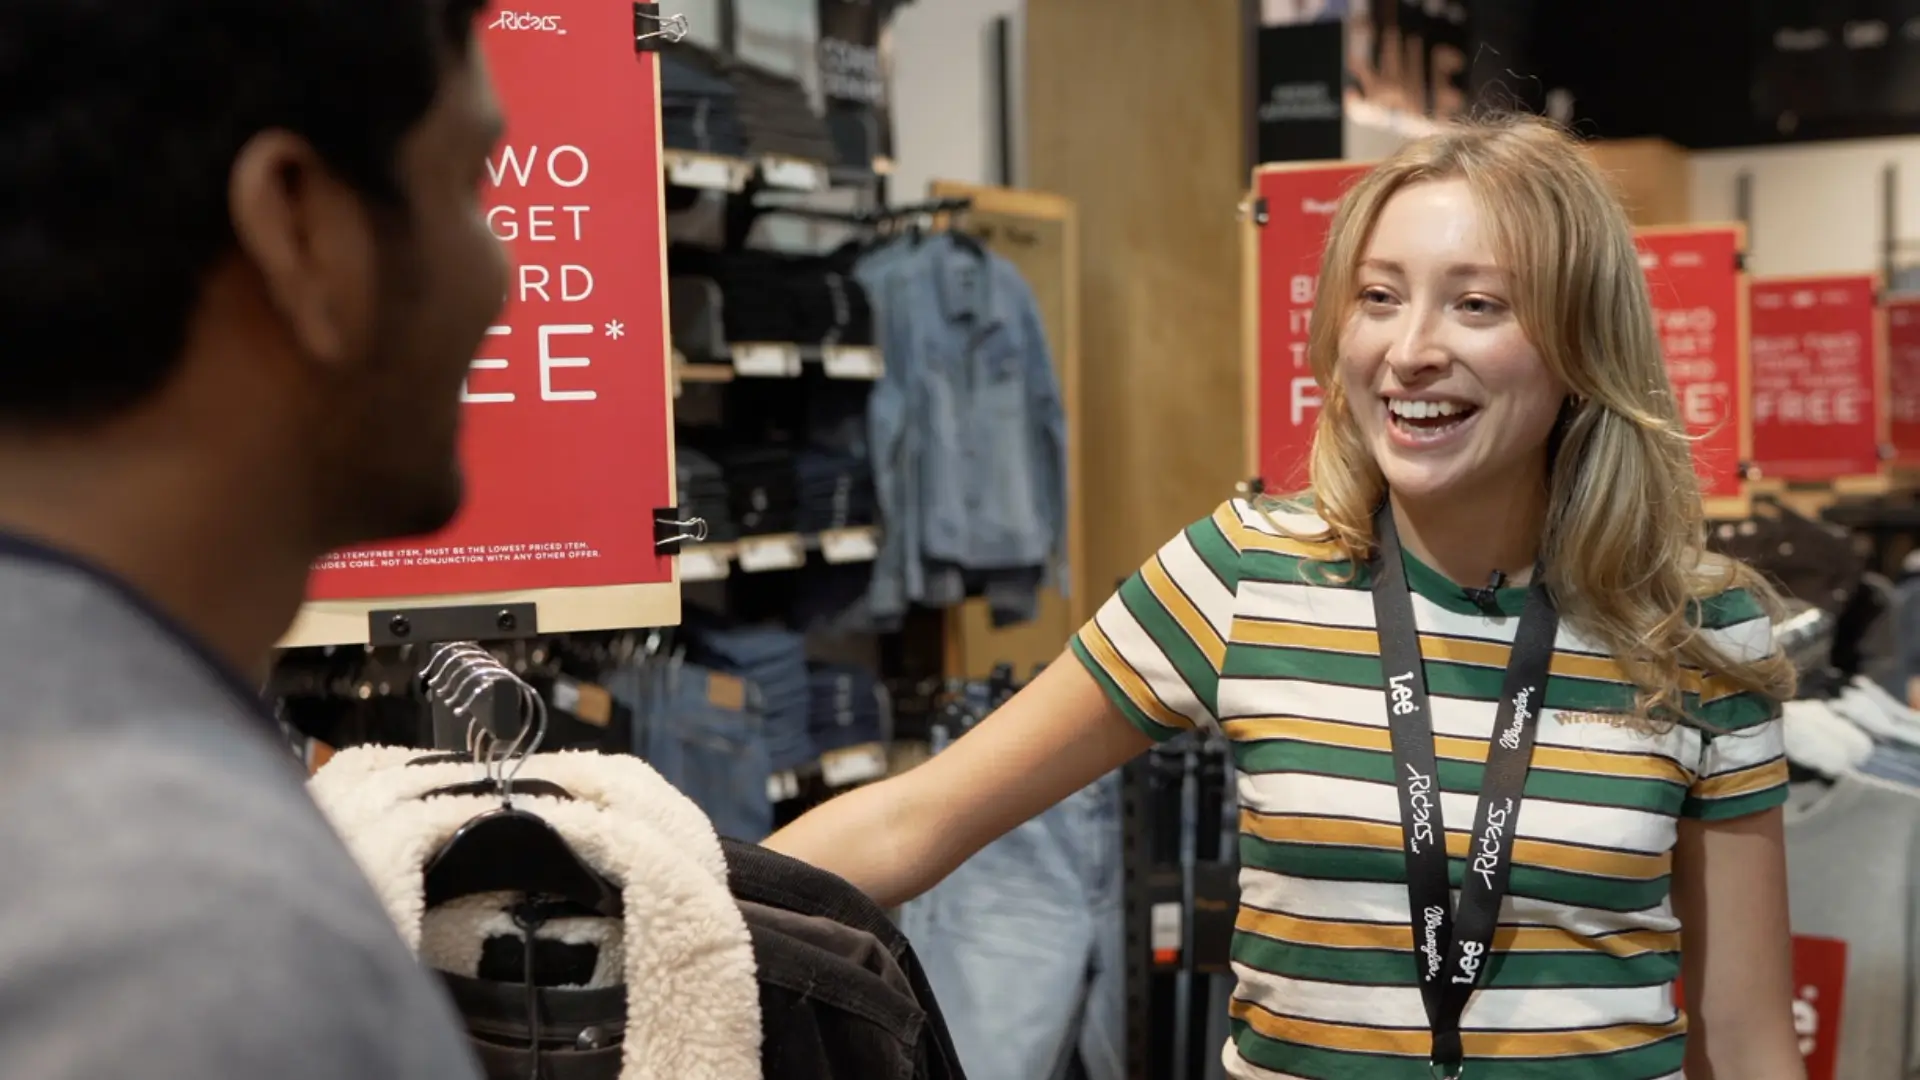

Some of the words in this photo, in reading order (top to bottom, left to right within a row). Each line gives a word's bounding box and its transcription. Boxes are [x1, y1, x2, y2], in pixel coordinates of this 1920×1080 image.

[485, 144, 589, 187] WO
[486, 205, 591, 241] GET
[518, 264, 594, 302] RD
[381, 558, 400, 568] NOT
[404, 558, 414, 567] IN
[416, 556, 484, 565] CONJUNCTION
[487, 554, 511, 563] WITH
[513, 553, 532, 562] ANY
[536, 551, 565, 561] OTHER
[425, 547, 449, 556] MUST
[453, 546, 464, 555] BE
[468, 545, 485, 554] THE
[489, 543, 525, 553] LOWEST
[528, 542, 562, 552] PRICED
[1389, 670, 1416, 716] Lee
[1451, 940, 1485, 984] Lee
